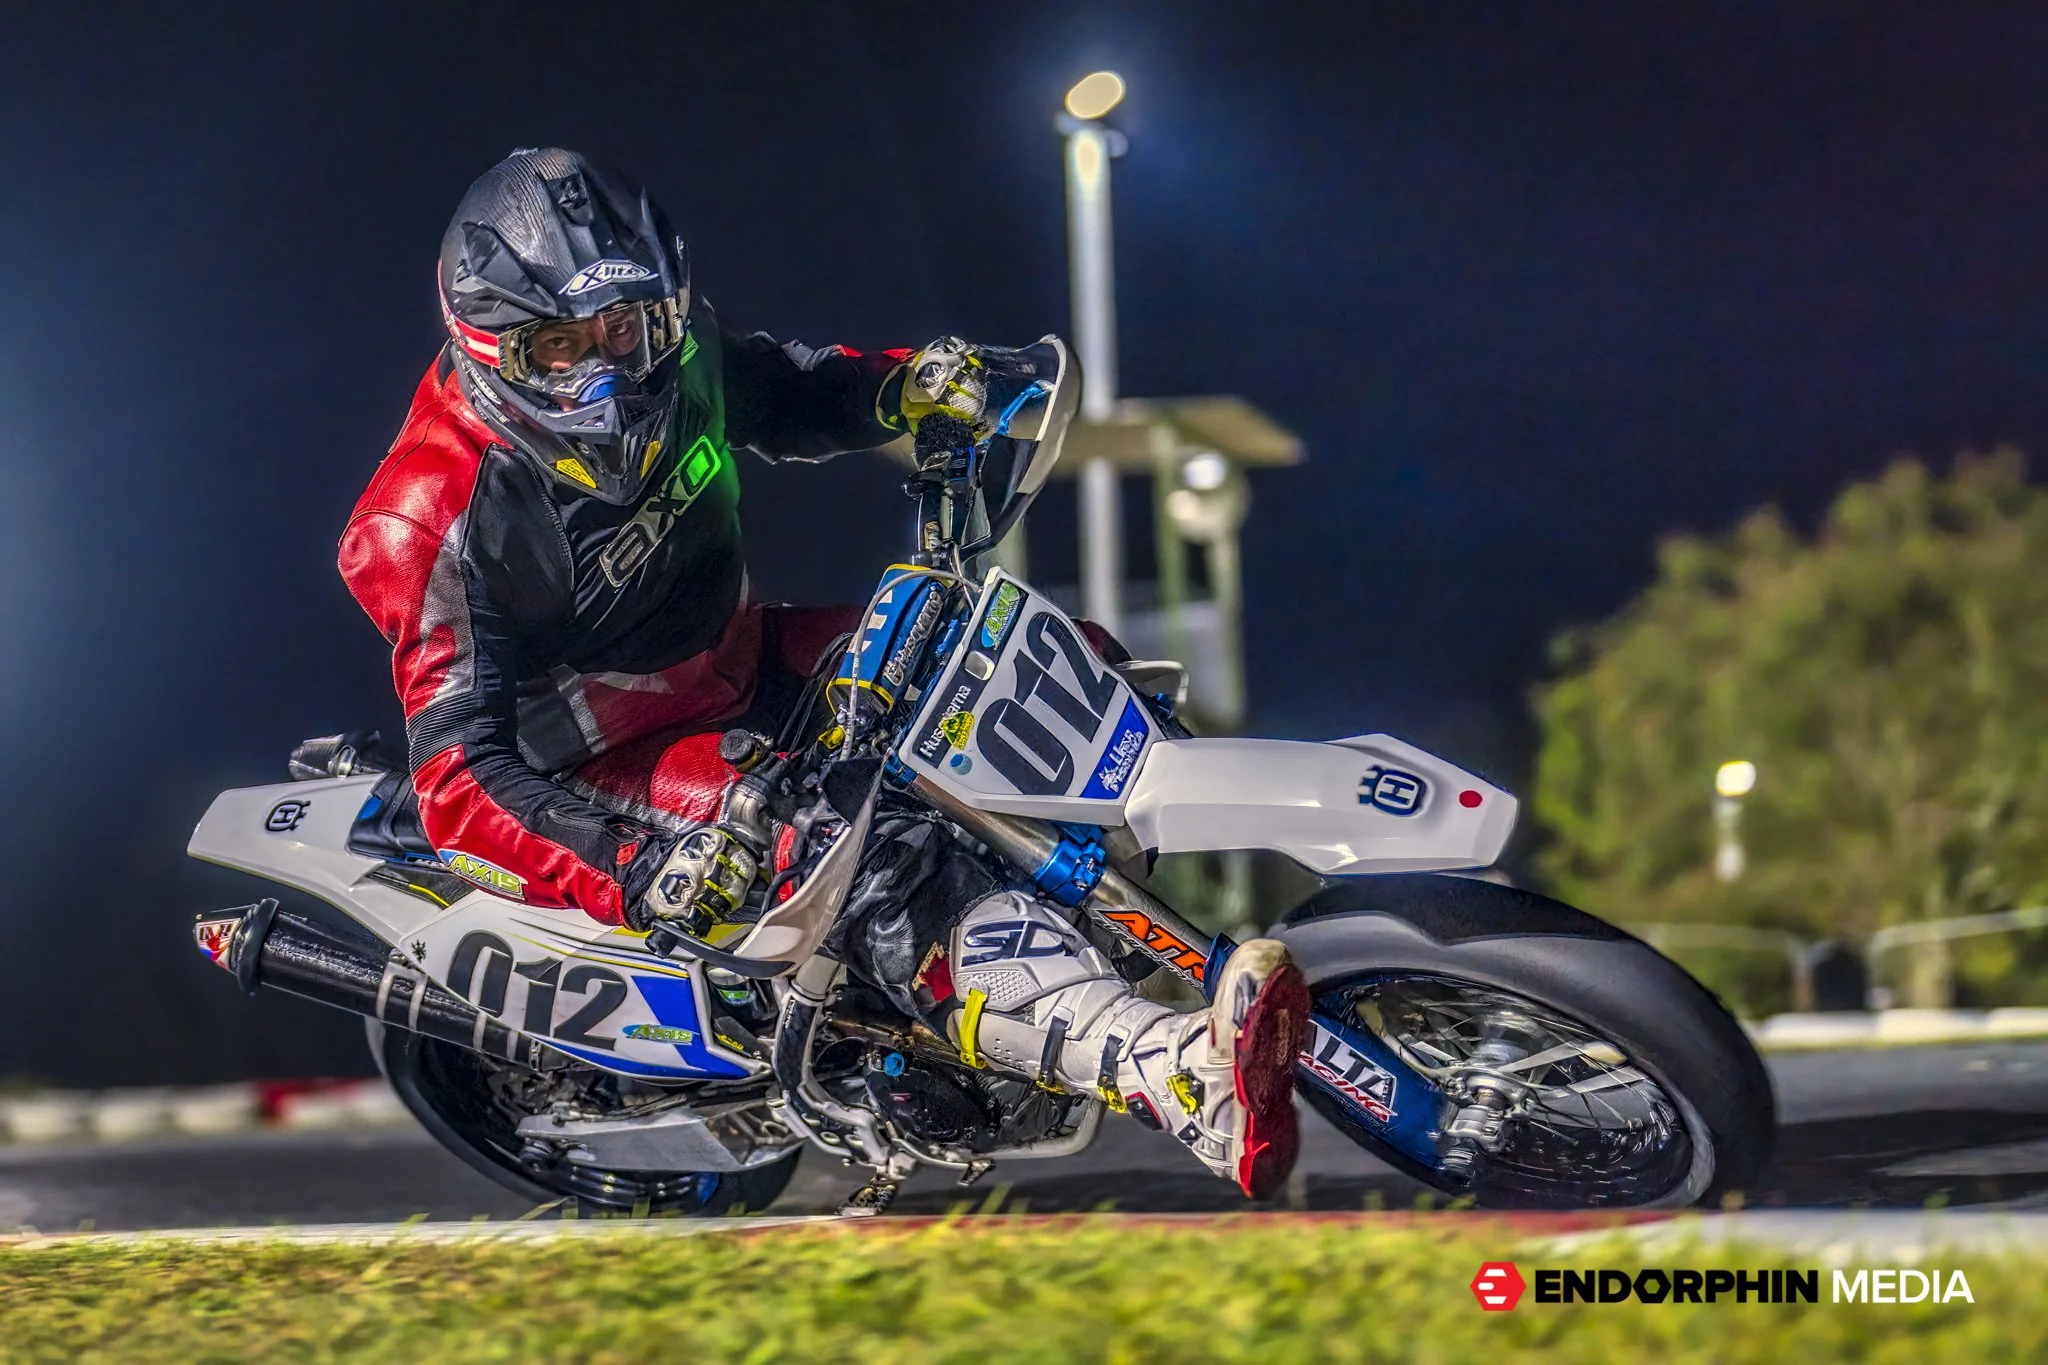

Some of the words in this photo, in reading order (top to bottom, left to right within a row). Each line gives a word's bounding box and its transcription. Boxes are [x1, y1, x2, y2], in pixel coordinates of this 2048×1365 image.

[976, 611, 1121, 797] 012
[448, 853, 521, 894] AXIS
[446, 929, 628, 1052] 012
